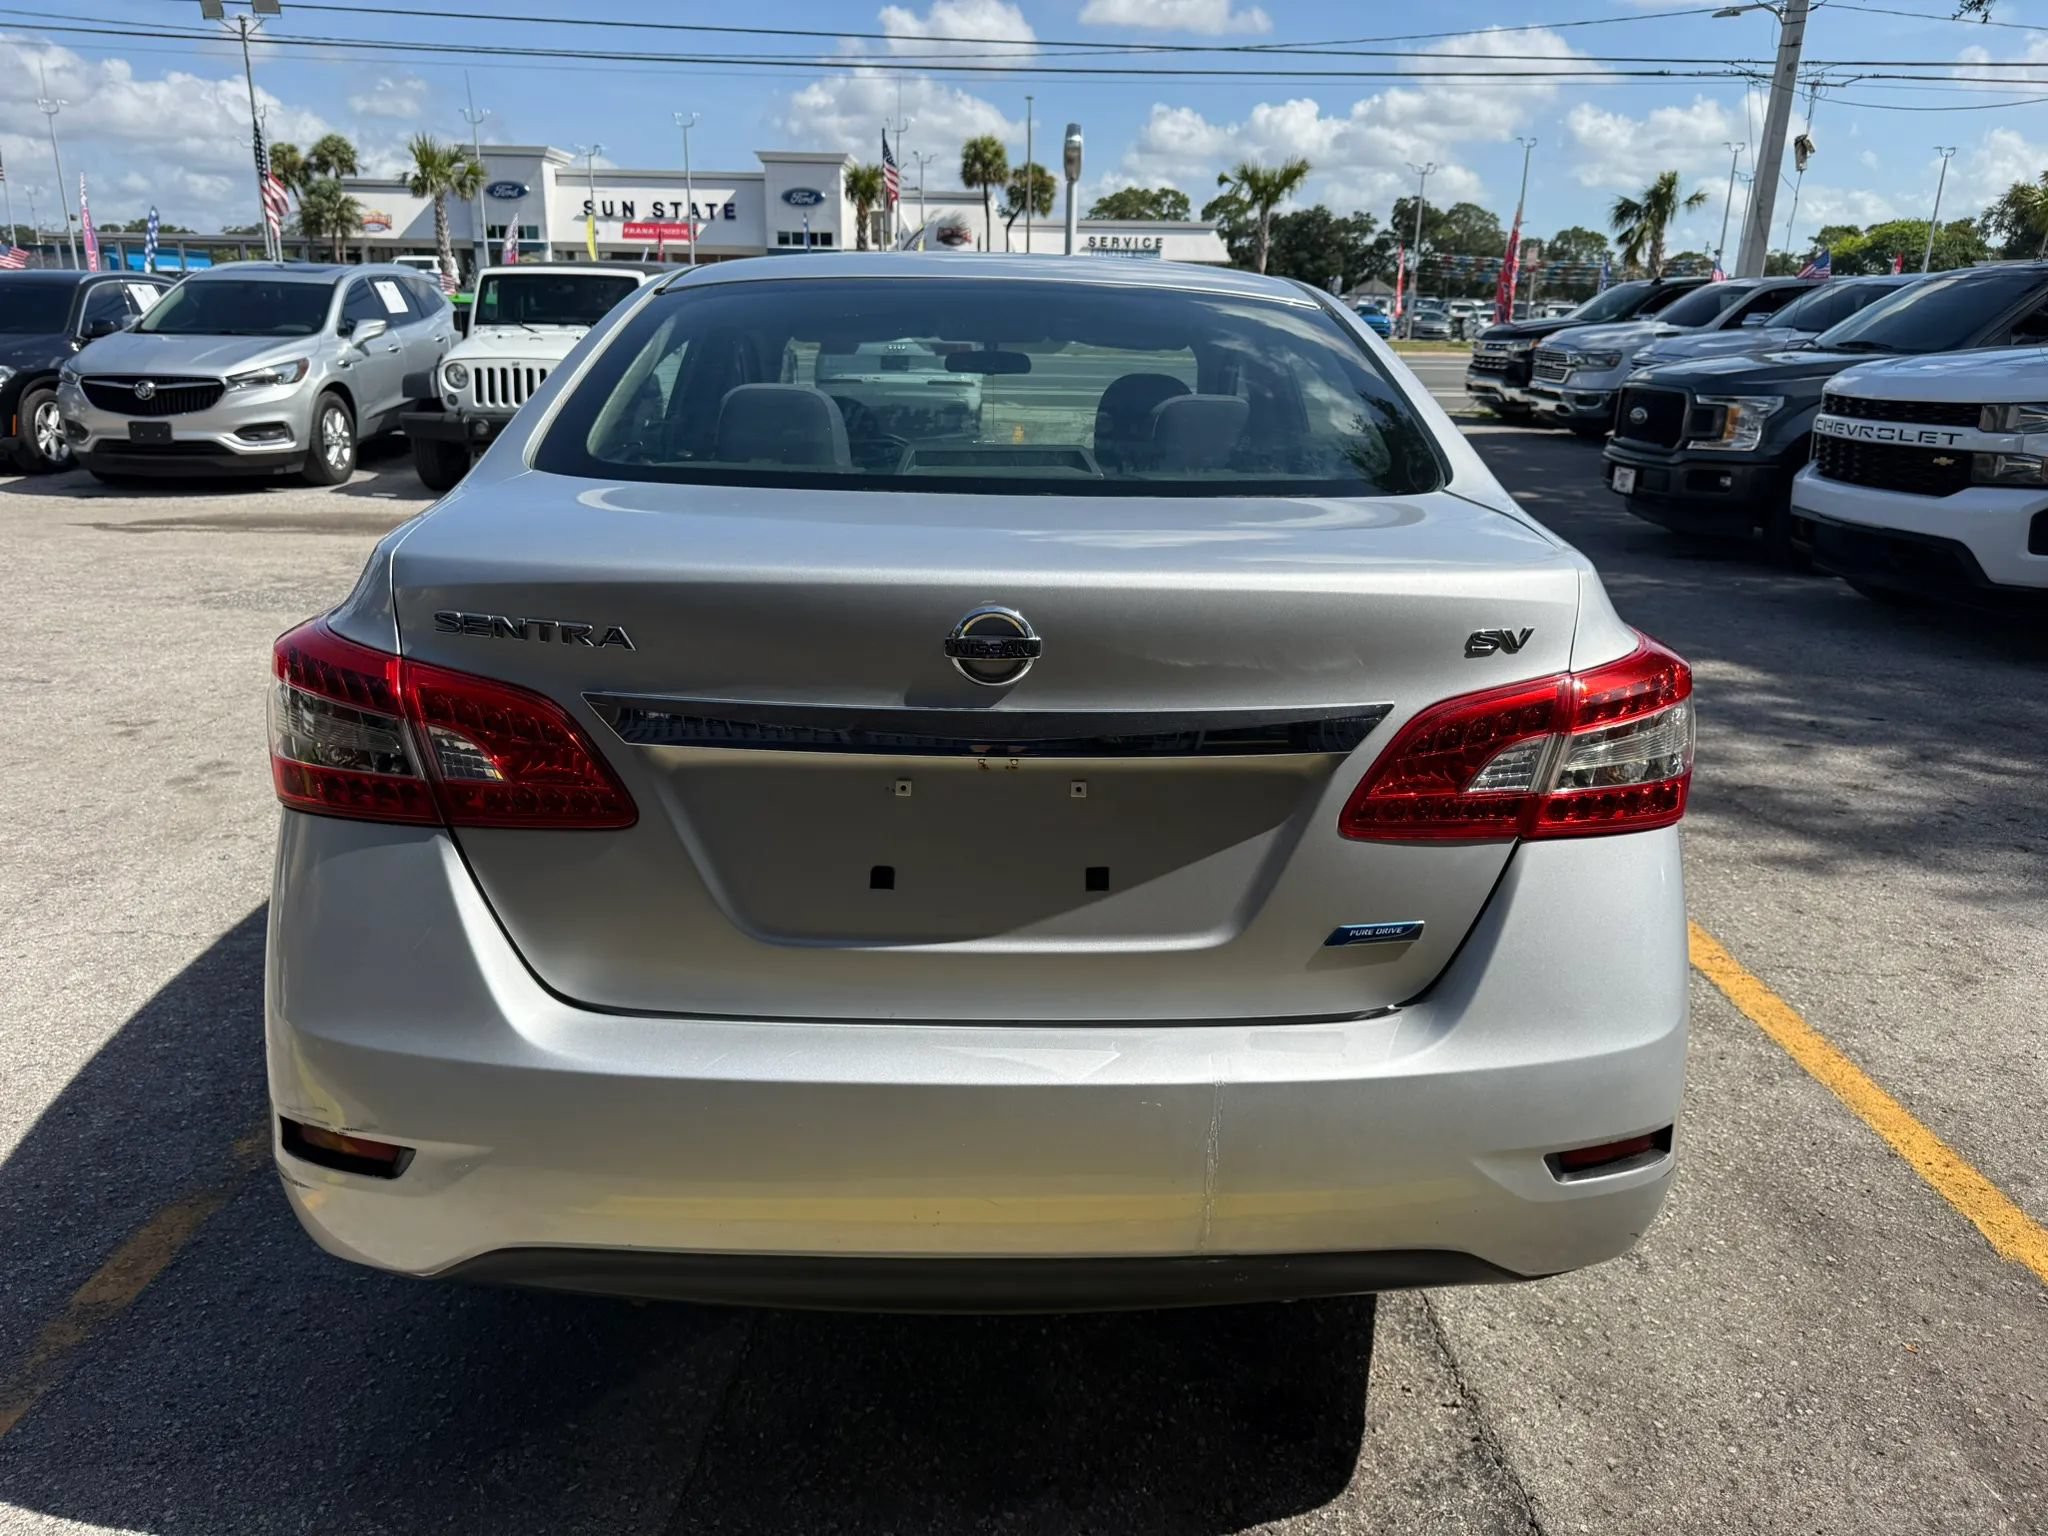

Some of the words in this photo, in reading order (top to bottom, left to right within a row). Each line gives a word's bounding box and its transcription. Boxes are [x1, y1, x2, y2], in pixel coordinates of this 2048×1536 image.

[493, 184, 519, 198] Ford
[790, 191, 816, 204] Ford
[583, 200, 635, 217] SUN
[653, 201, 737, 219] STATE
[1088, 236, 1164, 249] SERVICE
[1815, 419, 1963, 445] CHEVROLET
[433, 610, 637, 651] SENTRA
[956, 641, 1031, 656] NISSAN
[1464, 626, 1535, 658] SV
[1349, 928, 1374, 937] PURE
[1375, 926, 1404, 935] DRIVE
